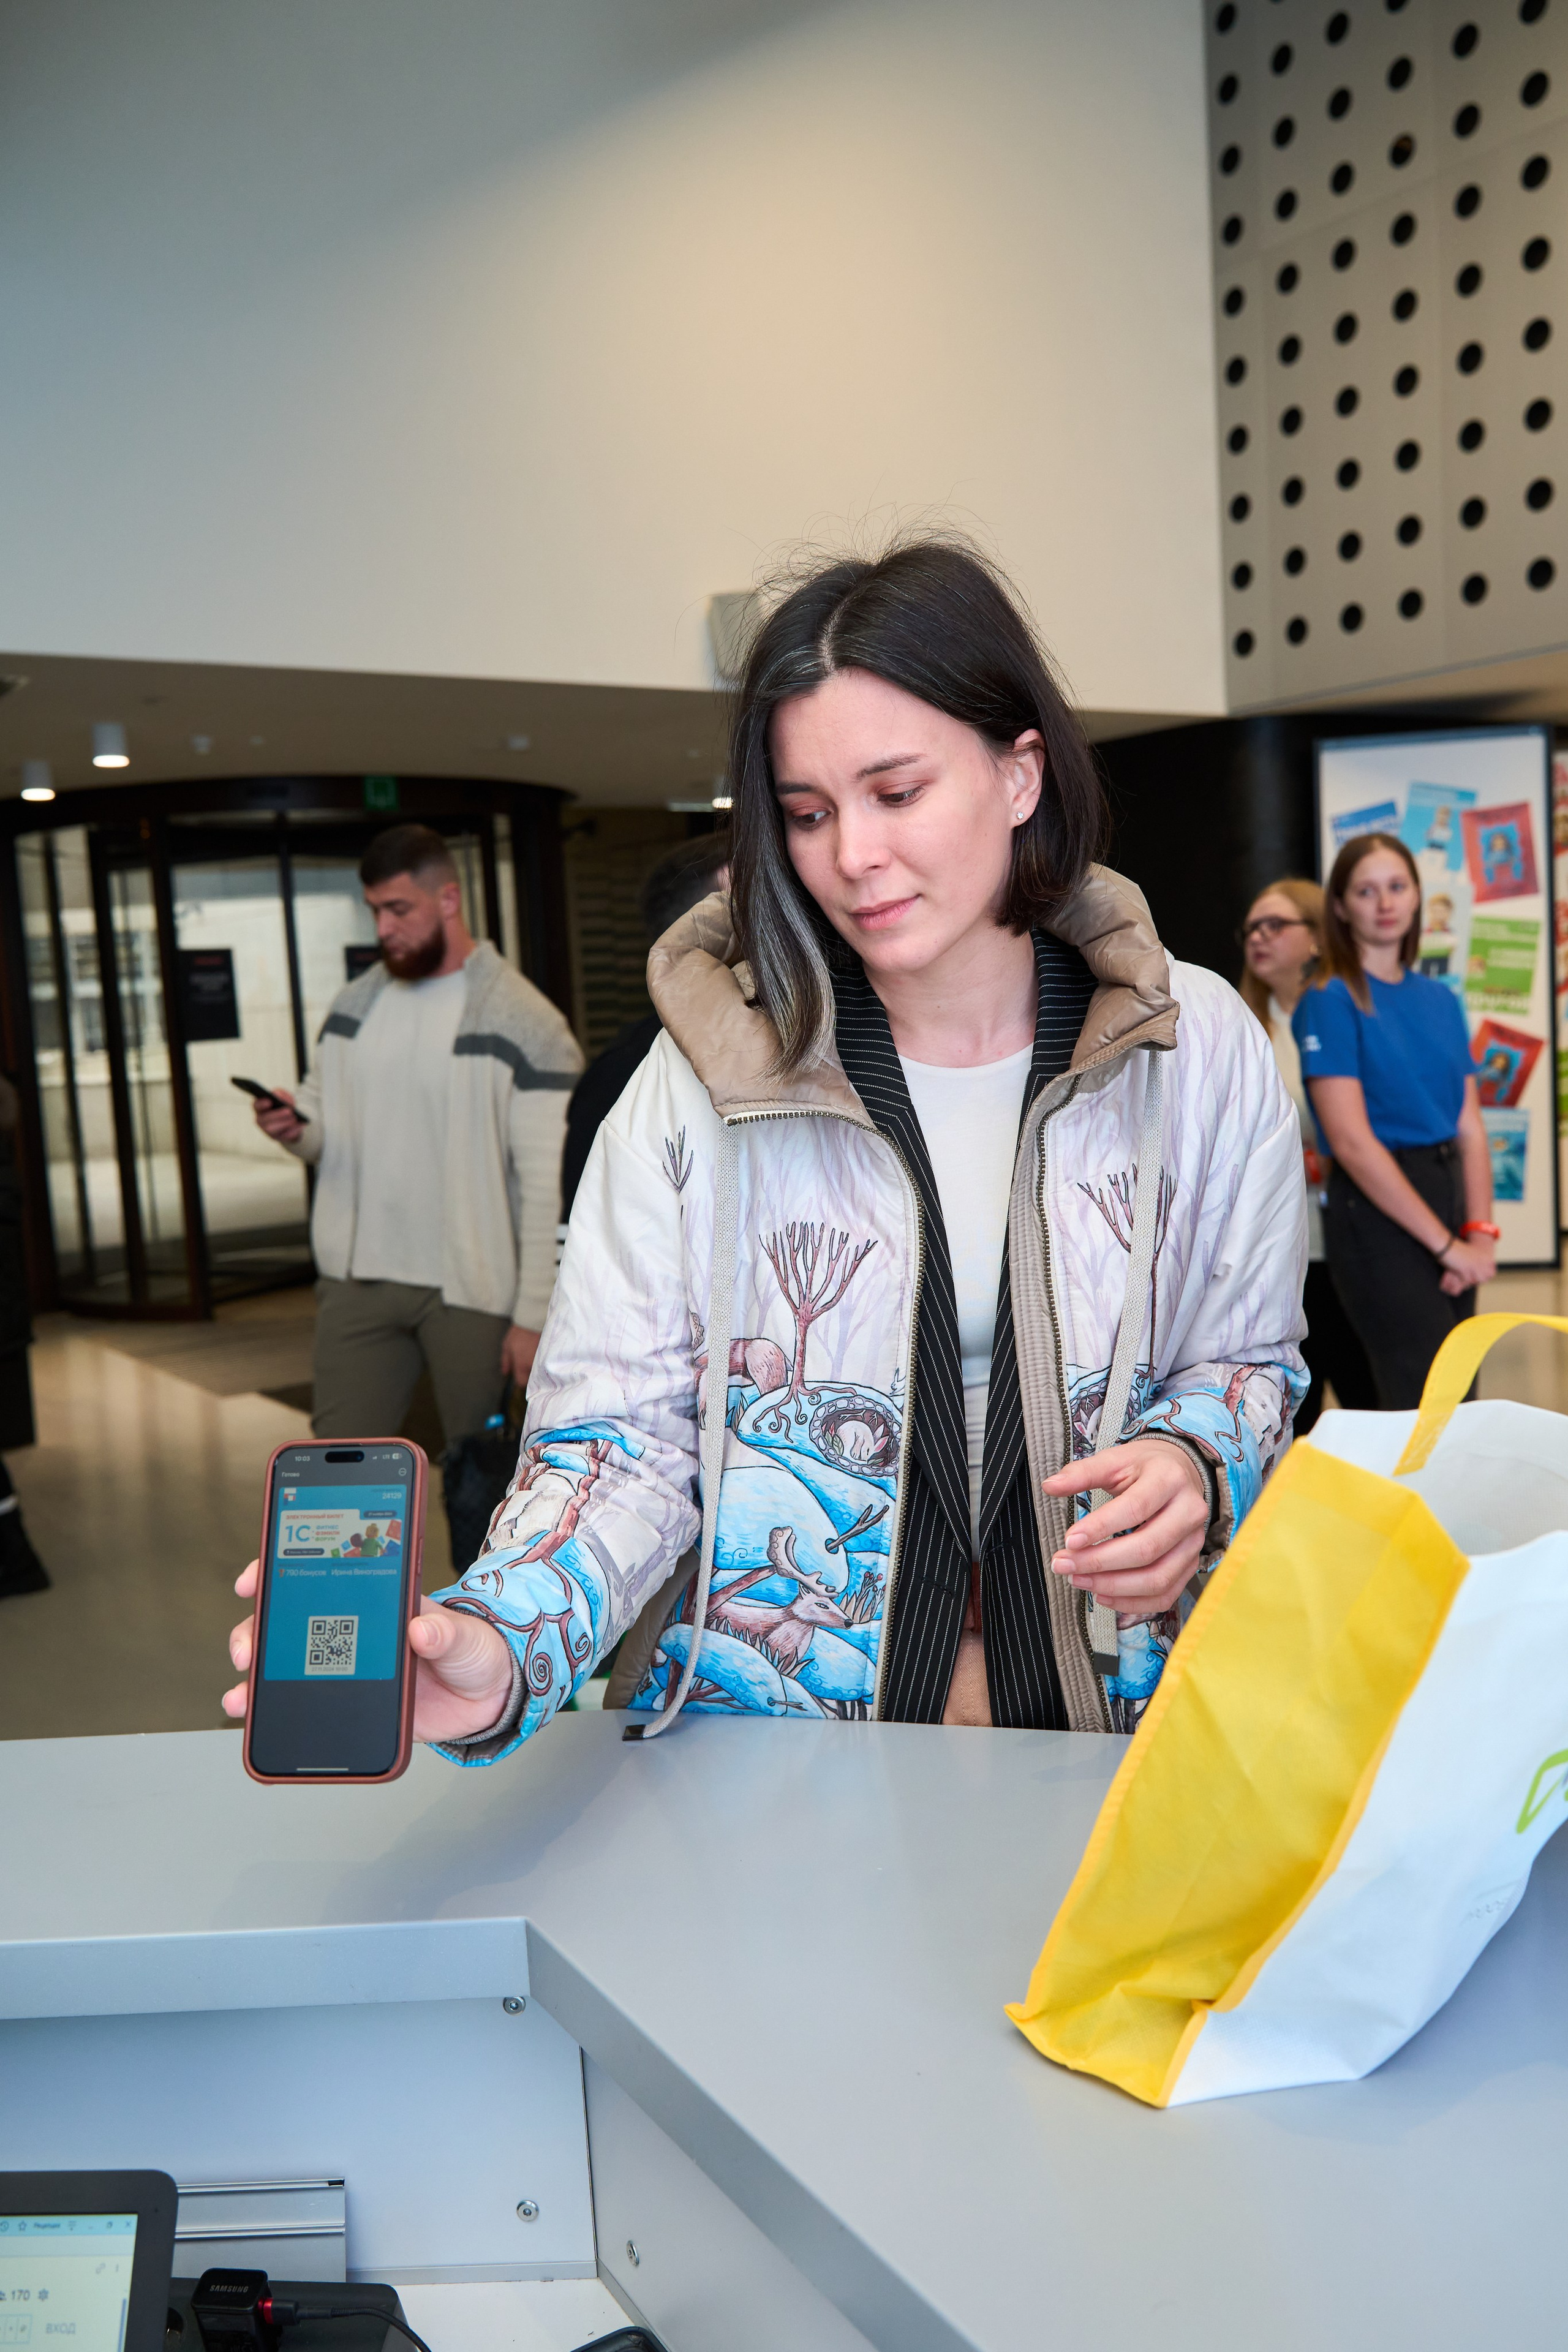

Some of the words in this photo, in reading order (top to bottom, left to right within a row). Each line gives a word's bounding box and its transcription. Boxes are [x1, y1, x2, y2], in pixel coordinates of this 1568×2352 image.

[11, 2289, 31, 2301] 170
[209, 2285, 249, 2293] SAMSUNG
[46, 2322, 76, 2335] ВХОД
